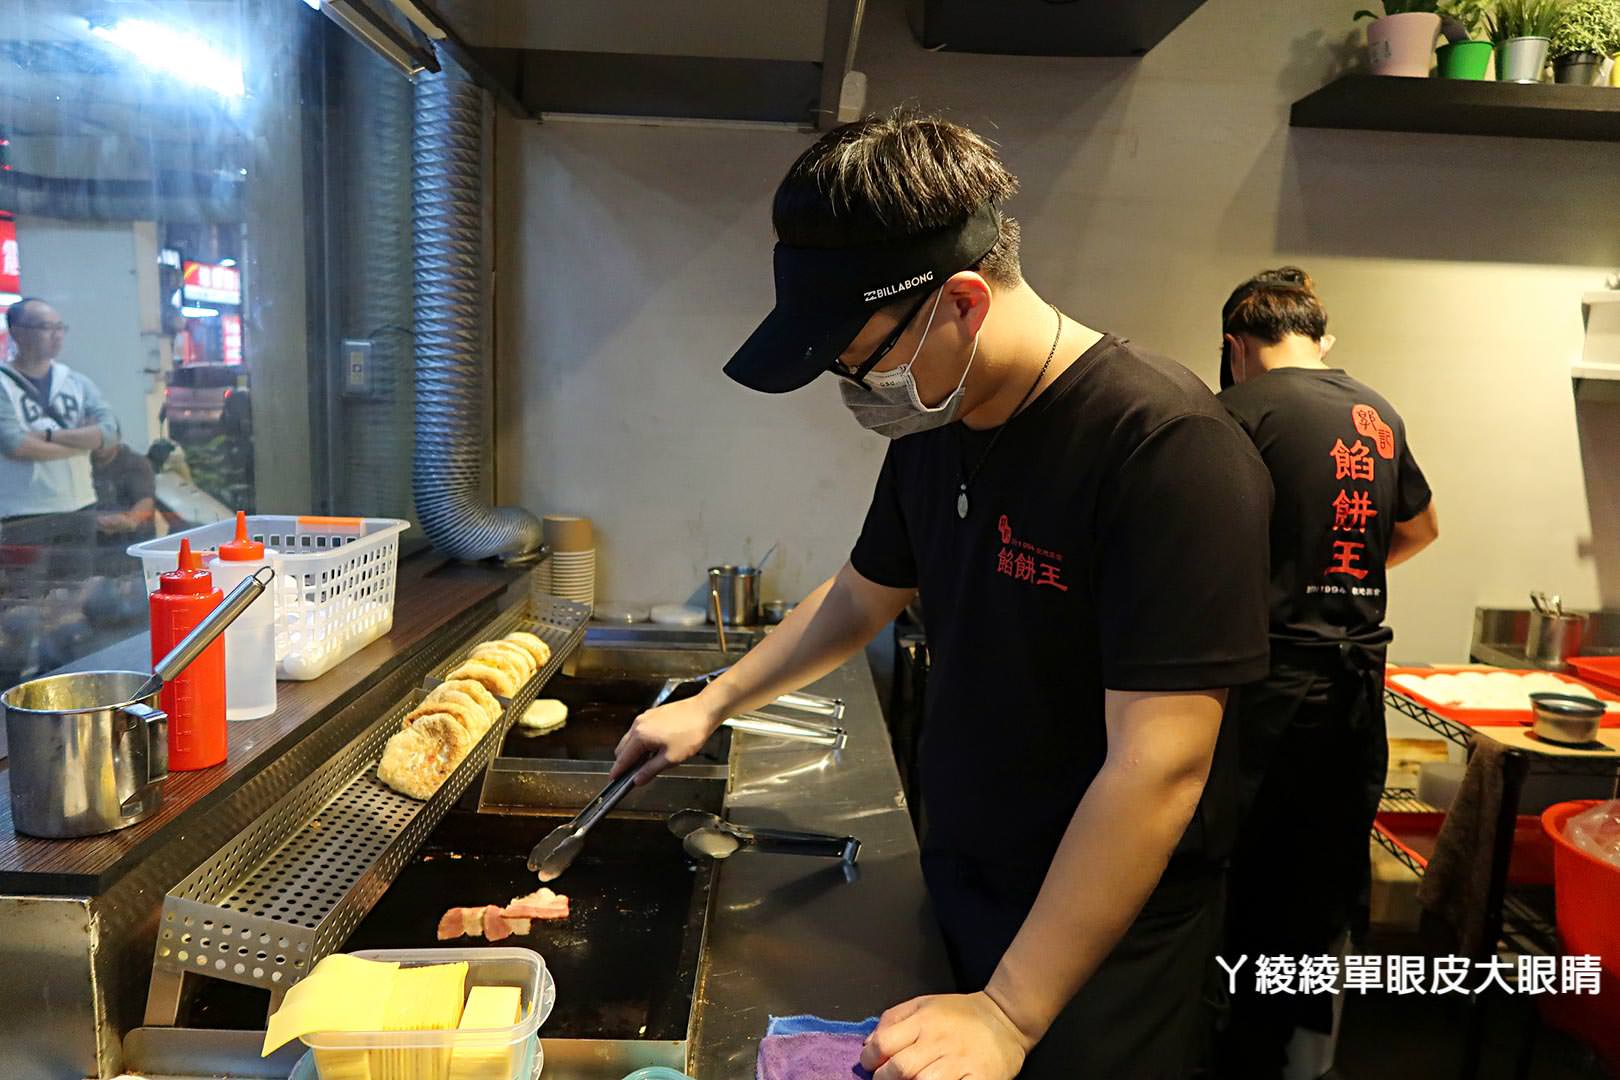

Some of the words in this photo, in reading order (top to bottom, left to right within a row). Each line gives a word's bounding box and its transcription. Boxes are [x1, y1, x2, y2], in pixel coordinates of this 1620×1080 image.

[877, 271, 934, 298] BILLABONG
[1324, 437, 1377, 581] 餡餅王
[996, 546, 1068, 592] 餡餅王
